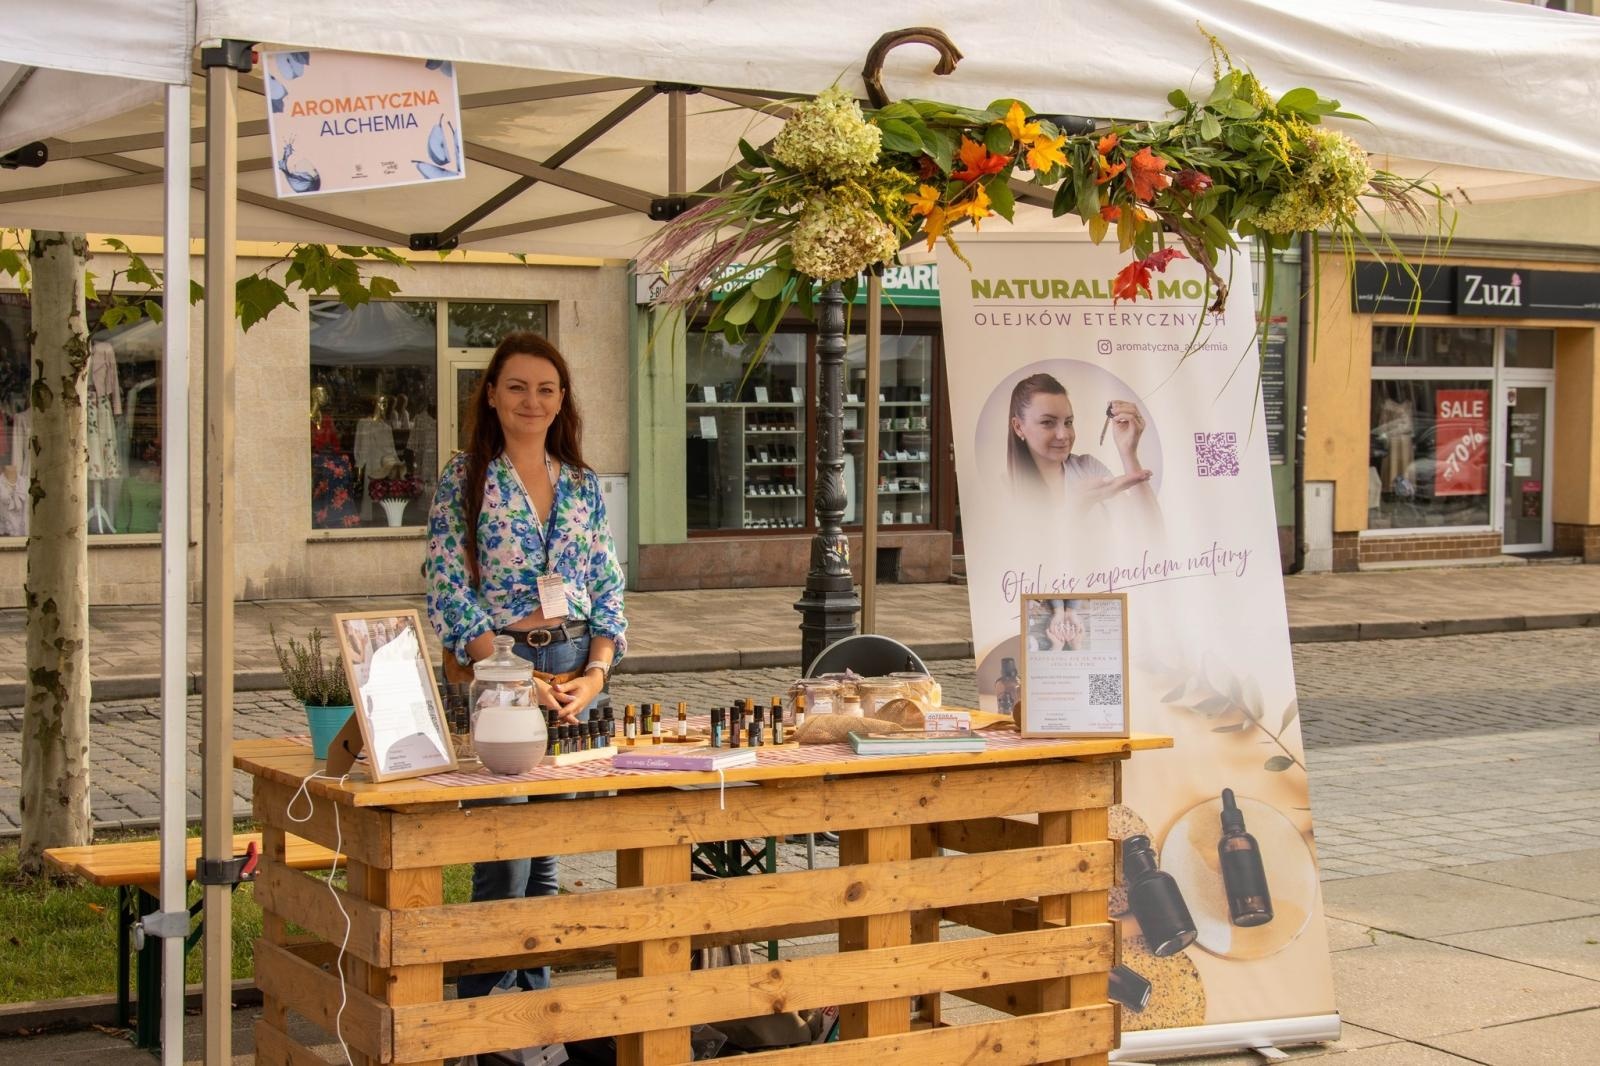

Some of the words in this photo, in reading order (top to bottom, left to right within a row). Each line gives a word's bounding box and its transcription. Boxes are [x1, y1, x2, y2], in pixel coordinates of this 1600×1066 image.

[291, 90, 440, 117] AROMATYCZNA
[320, 112, 418, 137] ALCHEMIA
[970, 279, 1149, 300] NATURALA
[1157, 279, 1220, 300] MOC
[1464, 273, 1522, 306] Zuzi
[974, 309, 1072, 327] OLEJKÓW
[1083, 312, 1226, 327] ETERYCZNYCH
[1115, 341, 1228, 354] aromatyczna_alchemia
[1440, 400, 1484, 418] SALE
[1085, 550, 1182, 593] zapachem
[1187, 541, 1253, 578] natury
